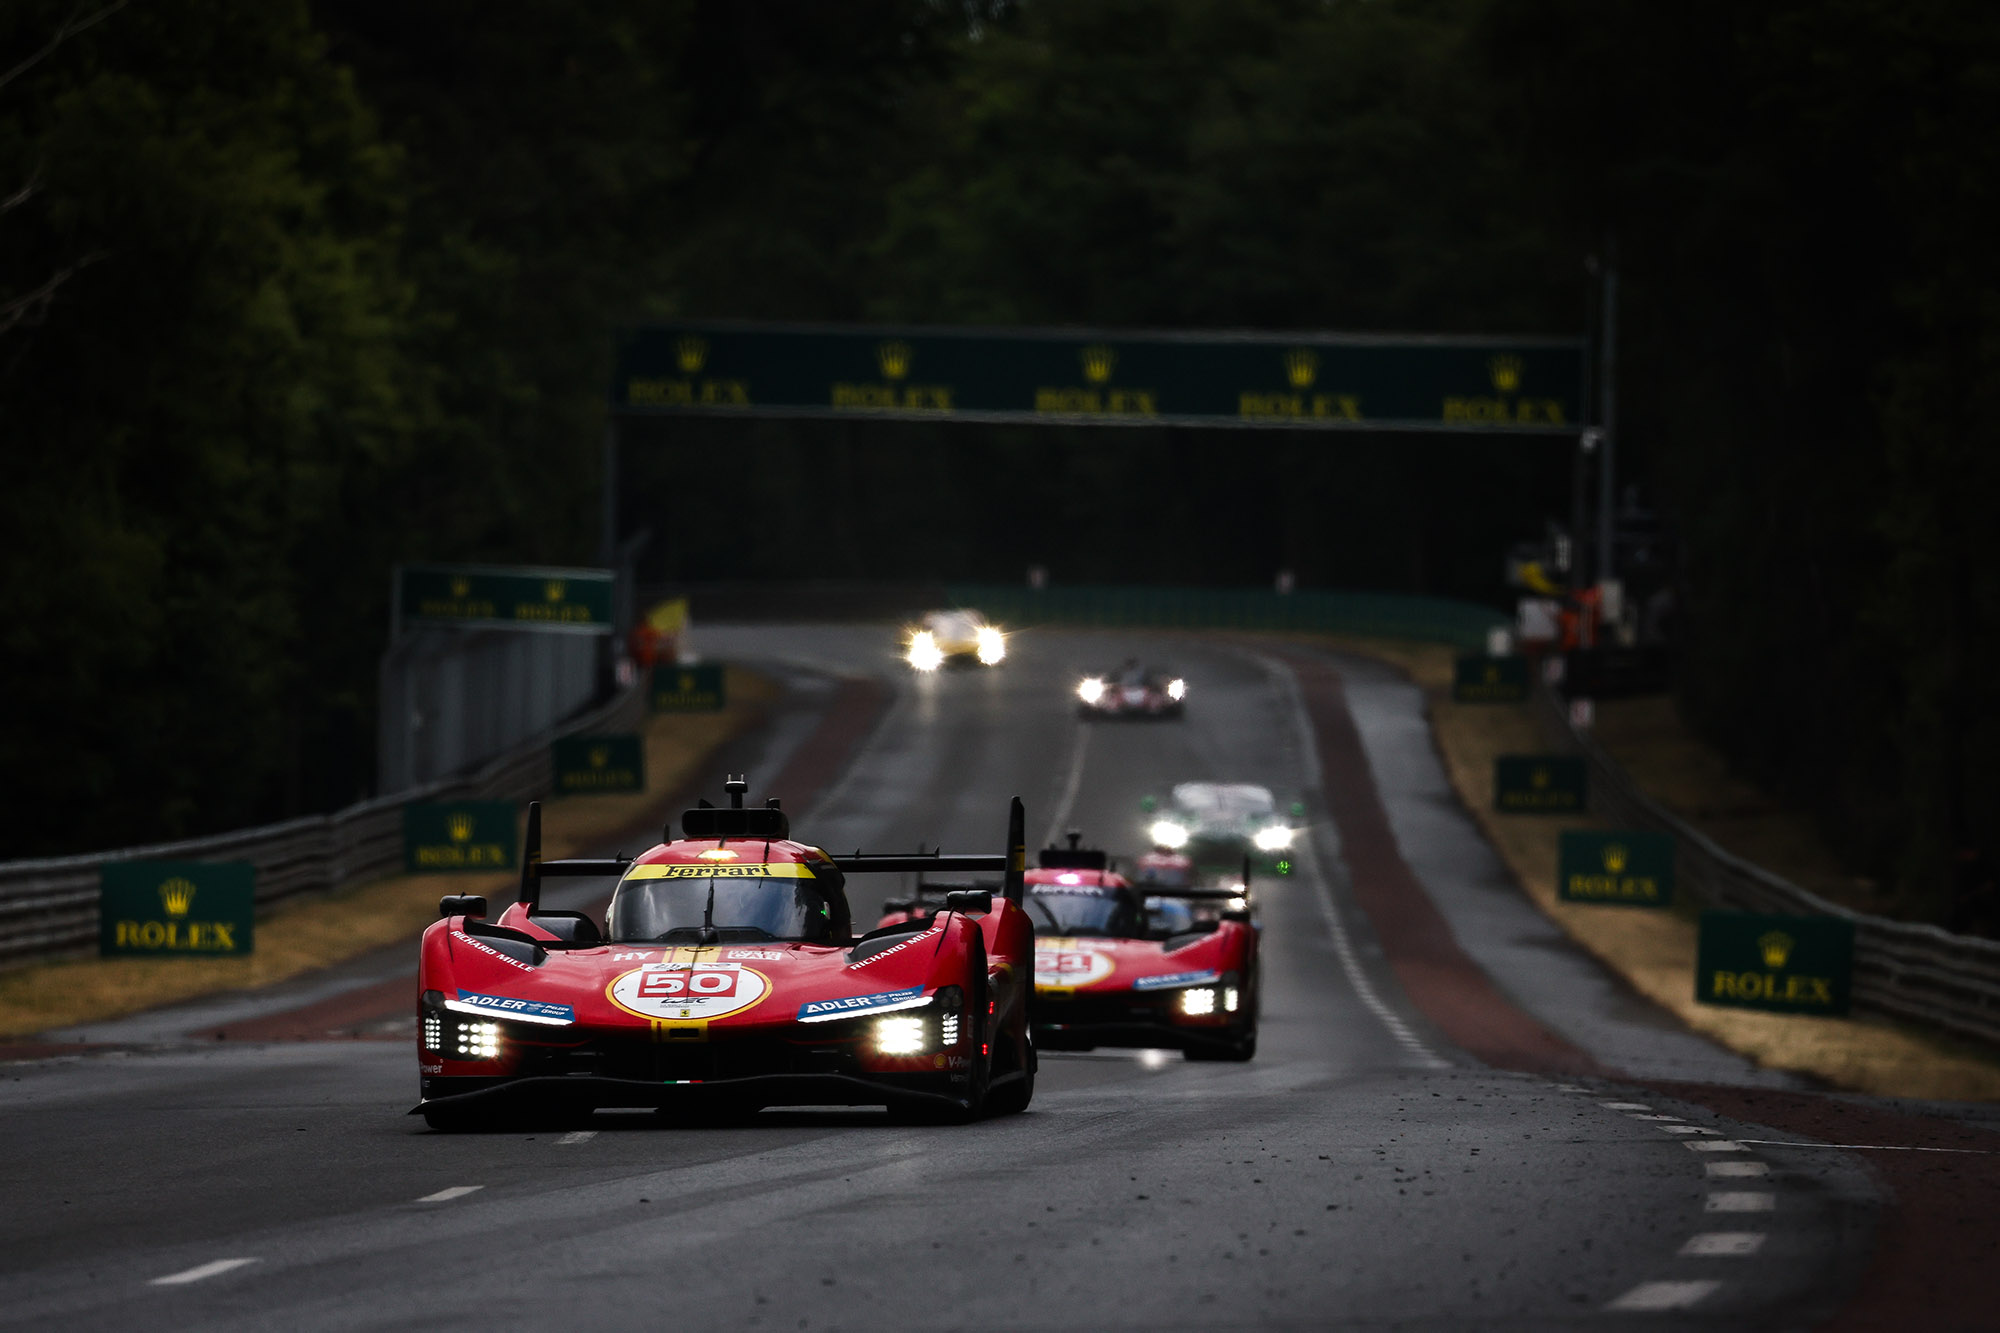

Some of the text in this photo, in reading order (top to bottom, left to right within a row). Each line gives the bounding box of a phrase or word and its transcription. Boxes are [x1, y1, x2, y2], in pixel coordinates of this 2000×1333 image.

[663, 864, 772, 877] Ferrari
[115, 920, 236, 950] ROLEX
[450, 930, 536, 973] RICHARD MILLE
[850, 926, 944, 970] RICHARD MILLE
[643, 973, 733, 994] 50
[1712, 970, 1835, 1004] ROLEX
[461, 995, 527, 1010] ADLER
[806, 997, 873, 1013] ADLER
